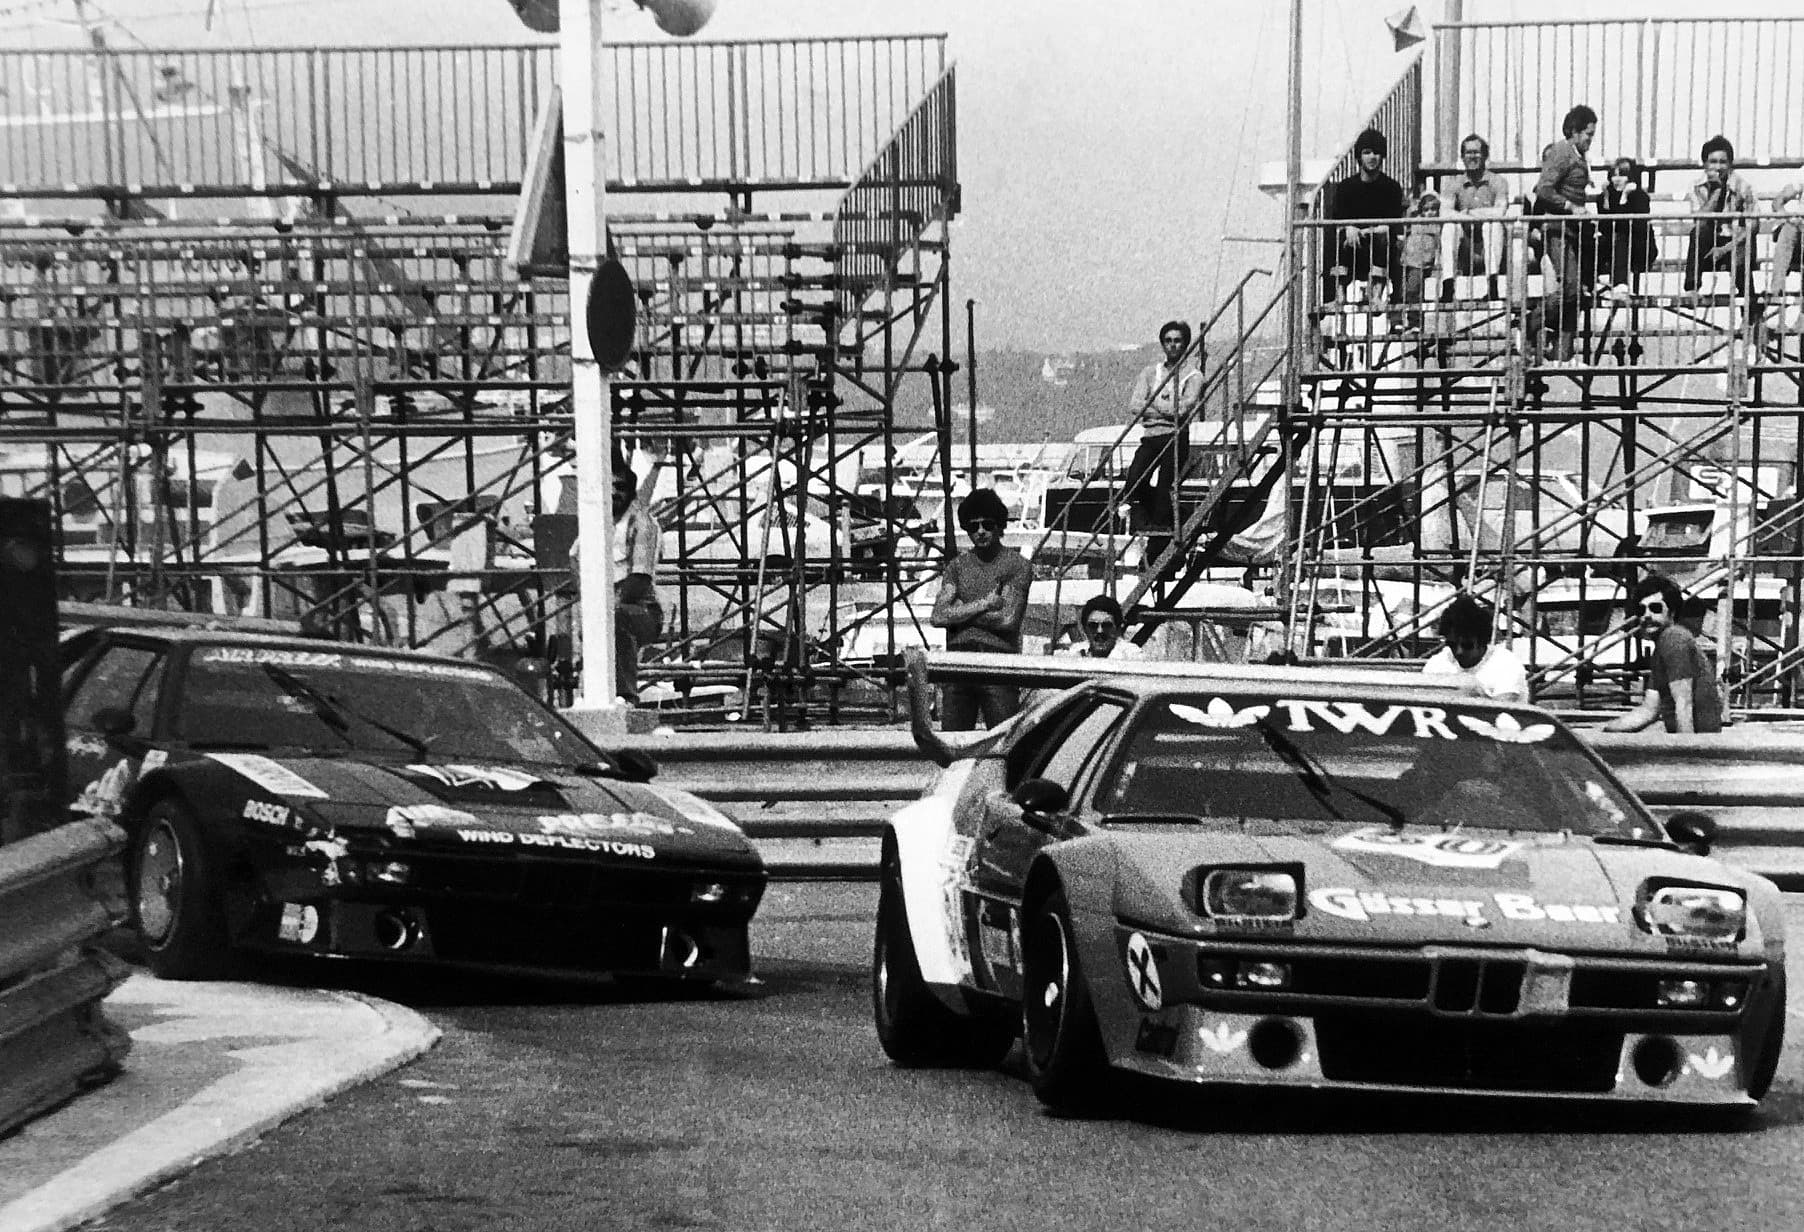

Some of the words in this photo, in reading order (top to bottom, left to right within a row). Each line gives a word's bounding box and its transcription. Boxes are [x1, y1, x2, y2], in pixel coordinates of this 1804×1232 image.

[1275, 699, 1458, 740] TWR
[243, 799, 290, 826] BOSCH
[457, 829, 514, 844] WIND
[518, 833, 656, 859] DEFLECTORS
